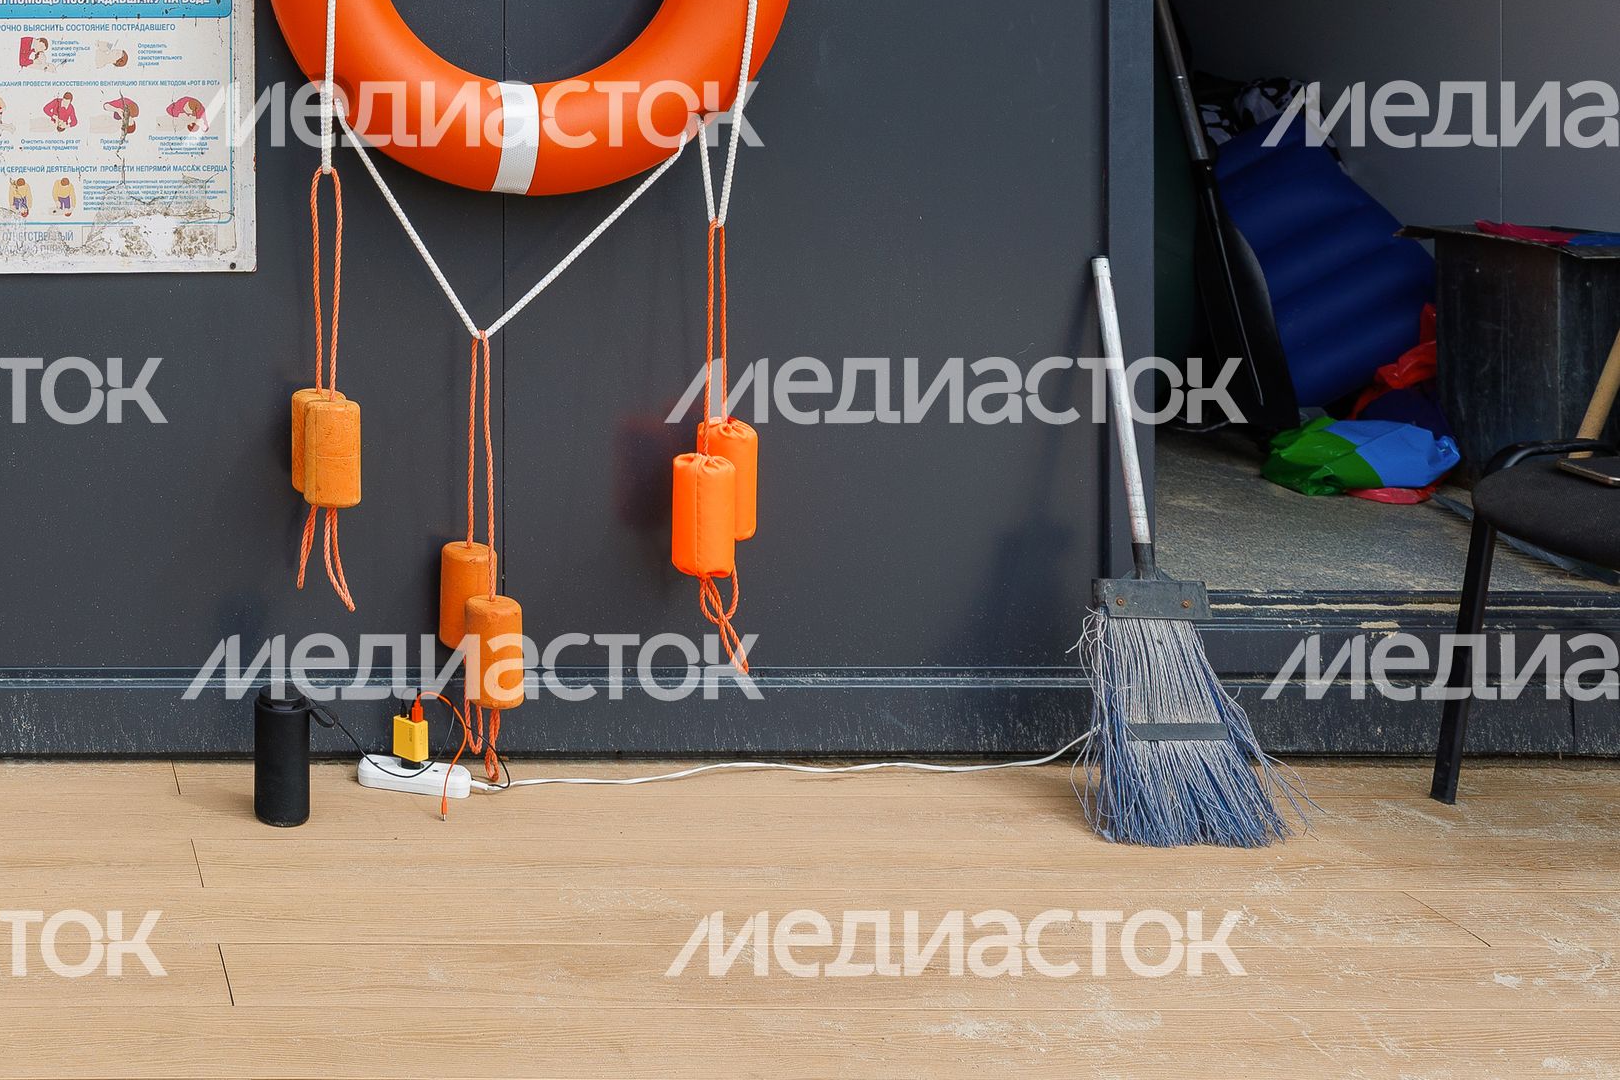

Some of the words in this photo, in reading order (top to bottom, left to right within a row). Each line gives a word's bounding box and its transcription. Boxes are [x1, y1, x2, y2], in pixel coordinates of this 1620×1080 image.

[23, 24, 64, 32] ВЫЯСНИТЬ
[65, 24, 110, 32] СОСТОЯНИЕ
[111, 23, 176, 32] ПОСТРАДАВШЕГО
